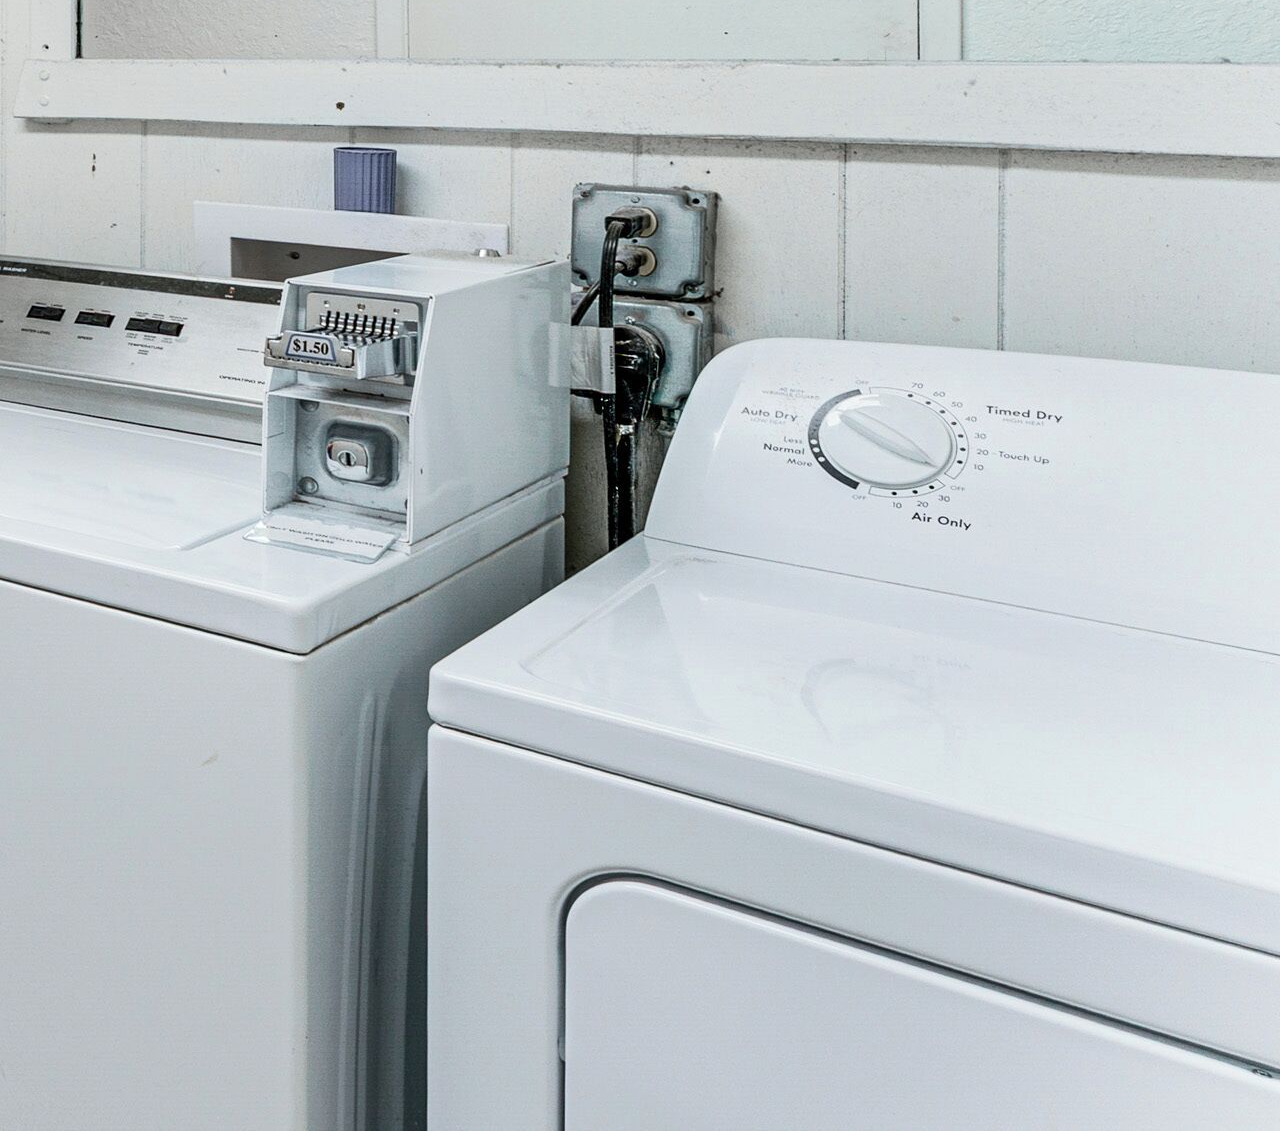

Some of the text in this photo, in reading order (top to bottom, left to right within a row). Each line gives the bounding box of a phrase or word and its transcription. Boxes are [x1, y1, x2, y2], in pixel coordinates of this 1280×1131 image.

[292, 338, 329, 356] $1.50
[911, 381, 924, 390] 70
[933, 390, 946, 398] 60
[951, 401, 963, 409] 50
[740, 406, 799, 423] Auto Dry
[986, 405, 1064, 424] Timed Dry
[783, 436, 803, 444] Less
[974, 432, 987, 440] 30
[763, 443, 806, 456] Normal
[976, 448, 1051, 466] 20 Touch Up
[787, 458, 813, 468] More
[973, 463, 984, 472] 10
[938, 495, 951, 503] 30
[892, 501, 903, 510] 10
[916, 501, 929, 509] 20
[911, 511, 972, 531] Air Only
[305, 536, 335, 545] PLEASE
